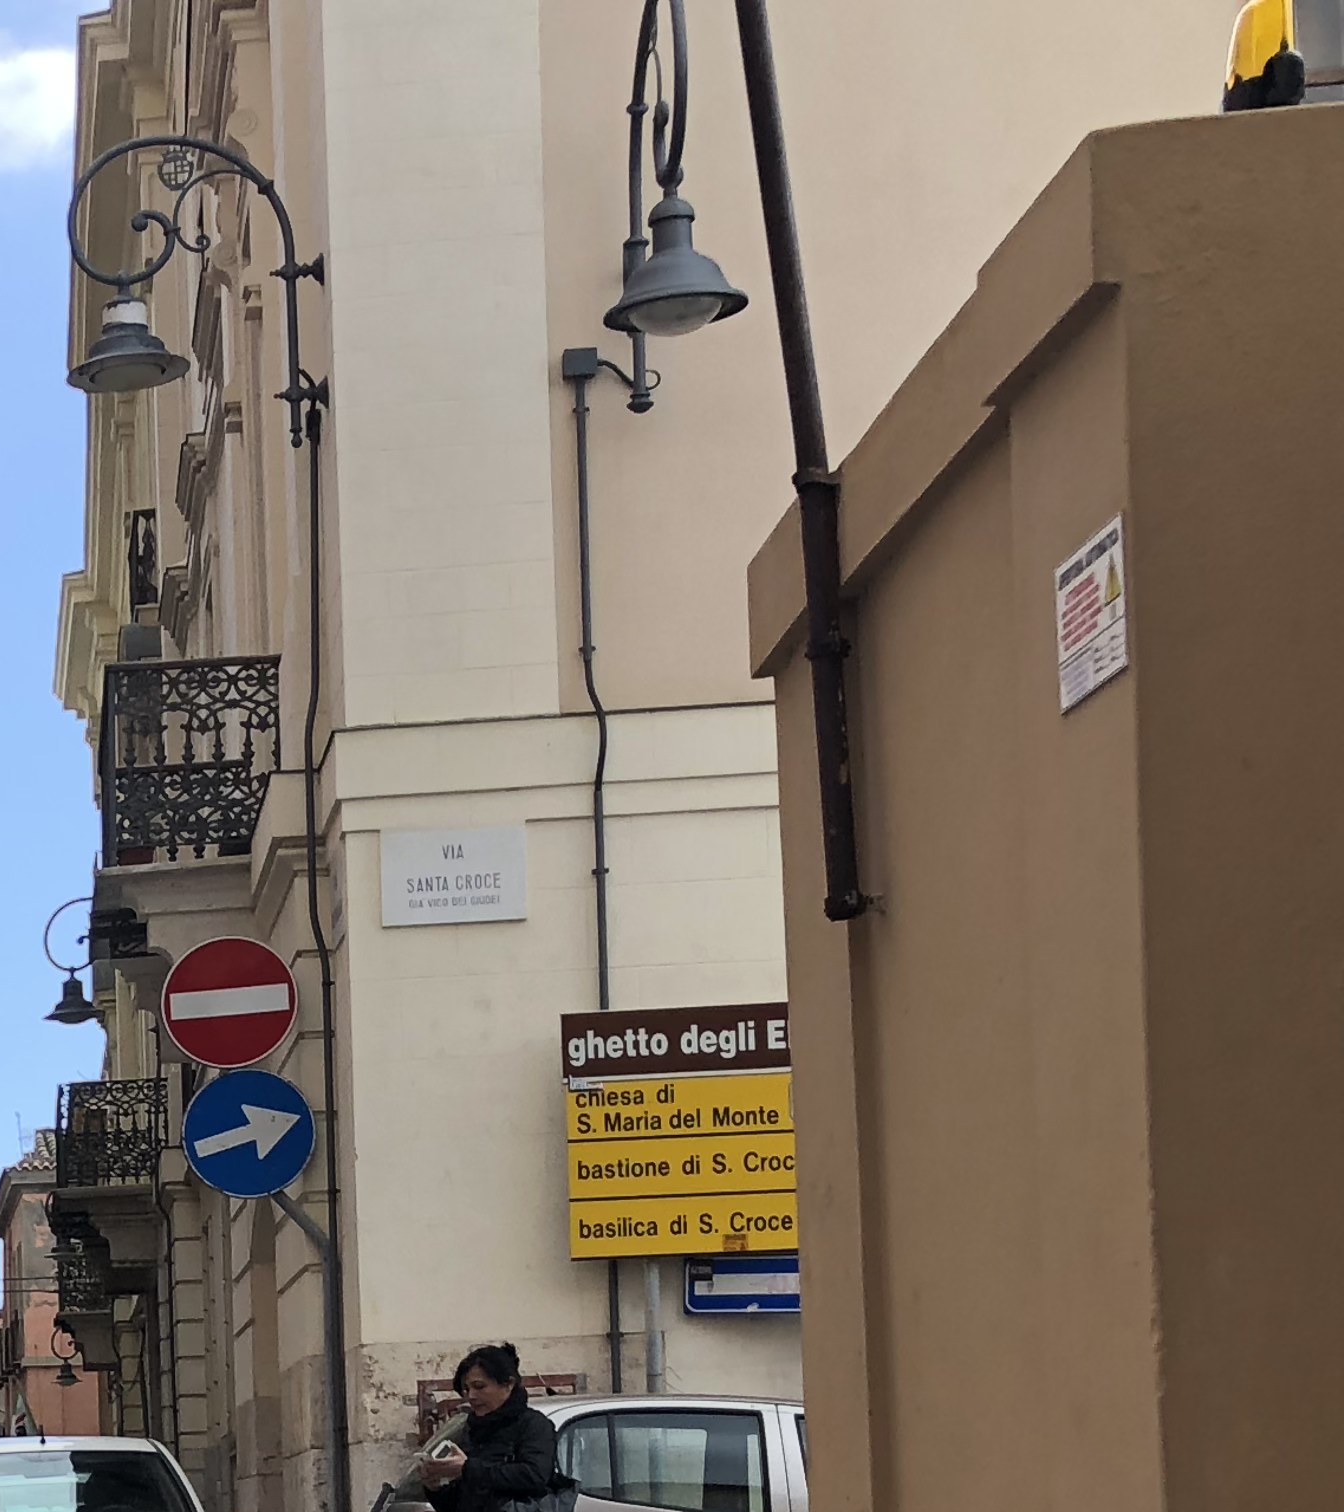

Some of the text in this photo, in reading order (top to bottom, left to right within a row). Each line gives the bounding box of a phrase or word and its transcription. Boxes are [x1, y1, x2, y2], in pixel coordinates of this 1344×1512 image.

[442, 844, 464, 859] VIA
[407, 873, 501, 893] SANTA CROCE
[568, 1027, 669, 1067] ghetto
[680, 1021, 756, 1059] degli
[575, 1084, 675, 1108] chiesa di
[577, 1106, 779, 1134] S. Maria del Monte
[577, 1158, 670, 1180] bastione
[682, 1155, 701, 1175] di
[712, 1154, 733, 1174] S.
[579, 1212, 793, 1239] basilica di S. Croce
